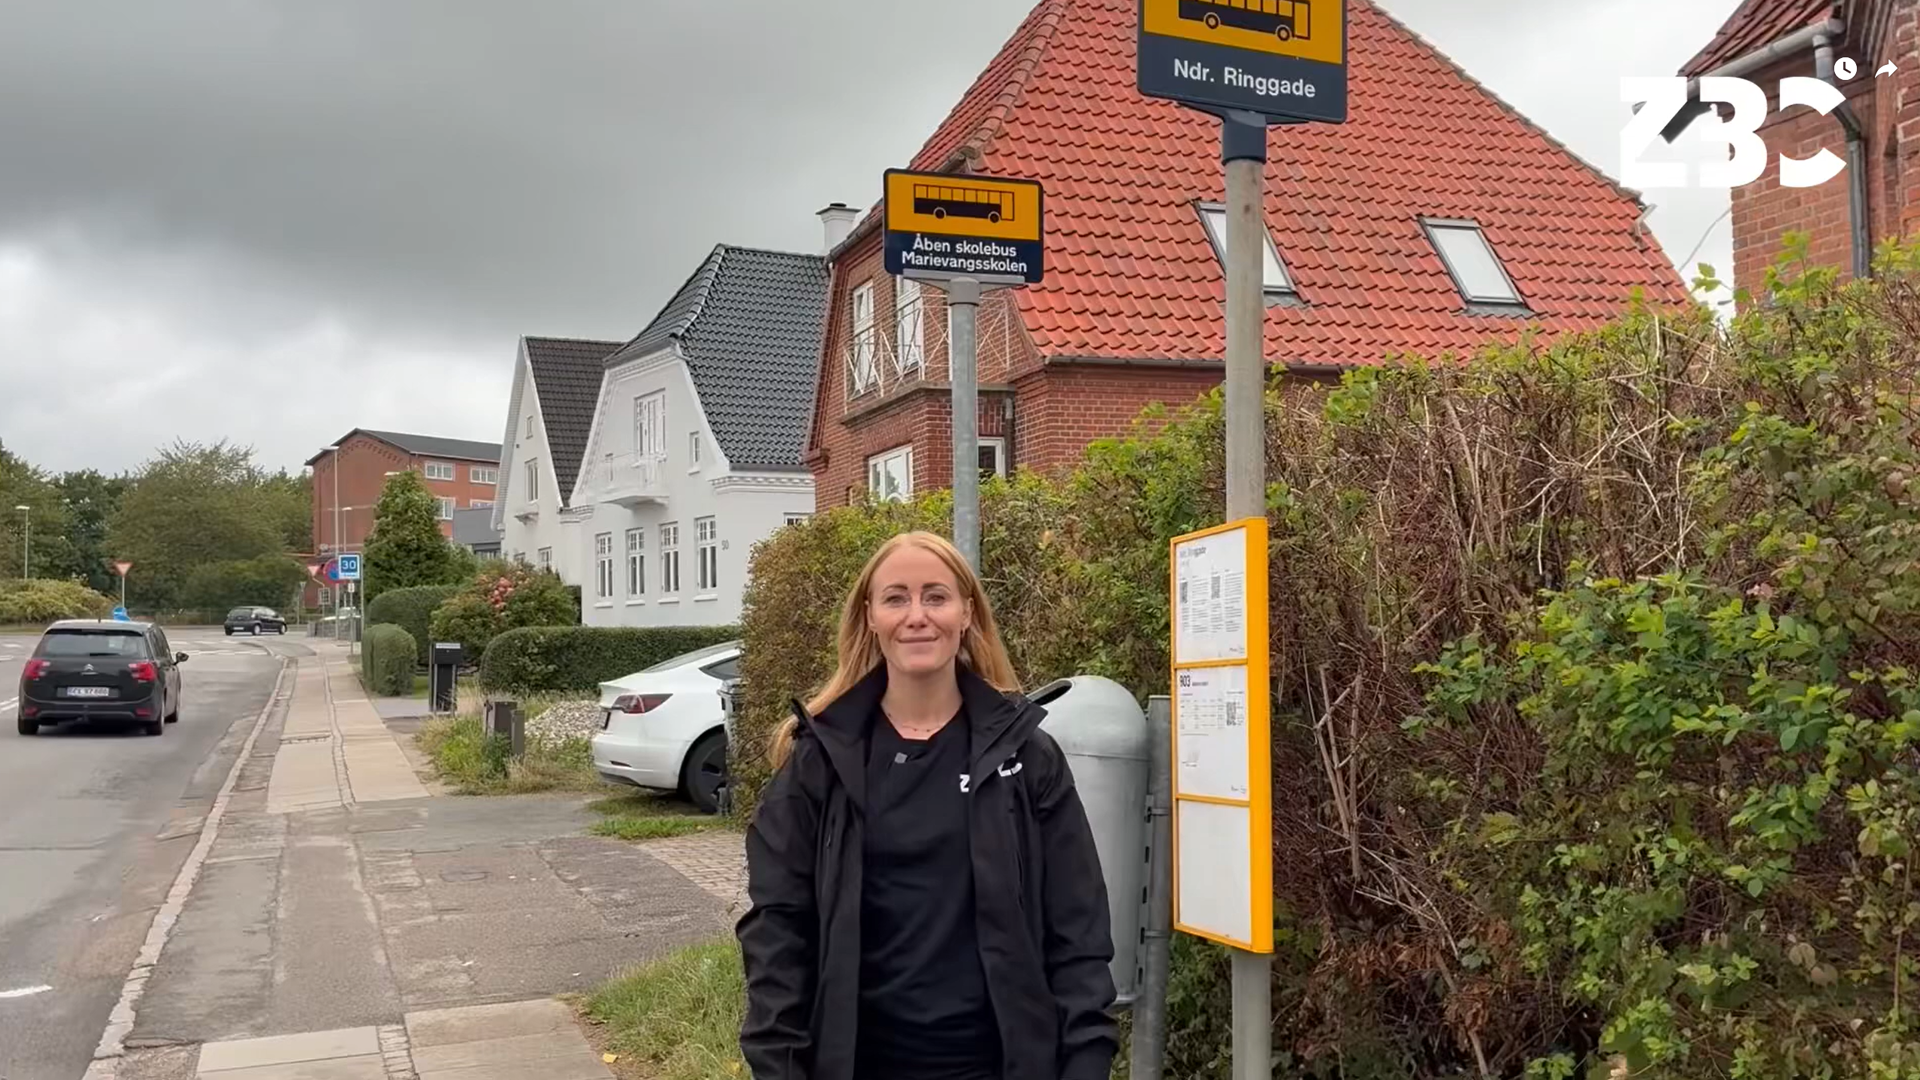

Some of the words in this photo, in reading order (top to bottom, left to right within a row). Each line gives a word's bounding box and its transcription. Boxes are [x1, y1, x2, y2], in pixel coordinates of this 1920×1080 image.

[1173, 58, 1215, 82] Ndr.
[1223, 66, 1316, 98] Ringgade
[913, 232, 950, 252] Åben
[955, 240, 1017, 257] skolebus
[901, 251, 1027, 273] Marievangsskolen
[342, 560, 356, 570] 30
